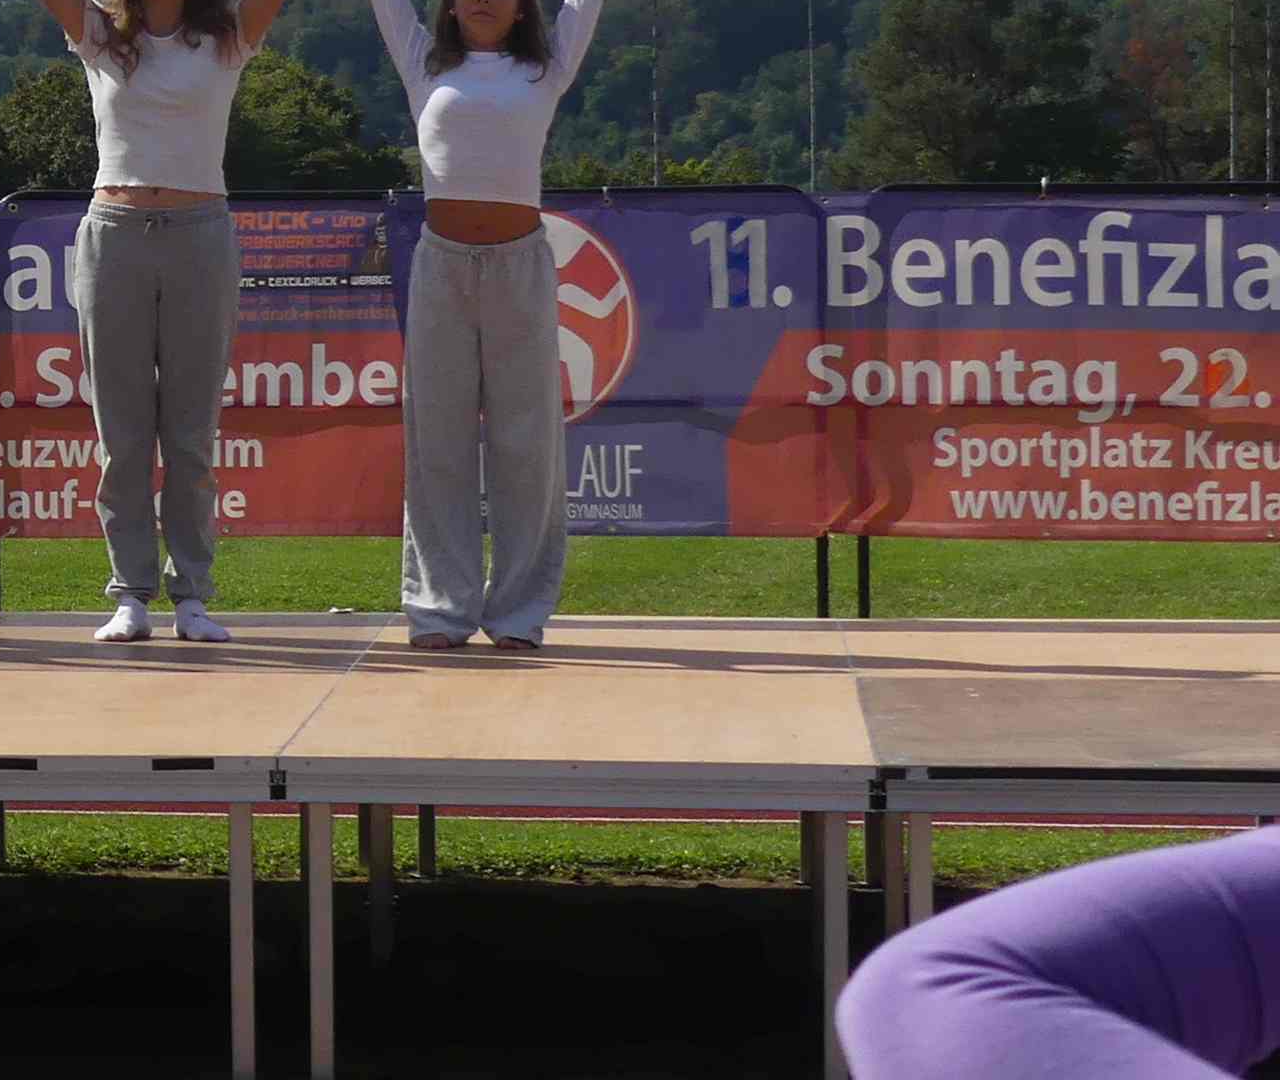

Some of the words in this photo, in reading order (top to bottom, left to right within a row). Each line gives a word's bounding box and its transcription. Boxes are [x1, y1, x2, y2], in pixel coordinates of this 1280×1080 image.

[690, 219, 793, 309] 11.
[826, 211, 1280, 311] Benefizla
[806, 344, 1137, 424] Sonntag,
[1159, 346, 1271, 409] 22.
[932, 426, 1172, 478] Sportplatz
[1184, 429, 1280, 470] Kreu
[950, 480, 1280, 522] www.benefizla
